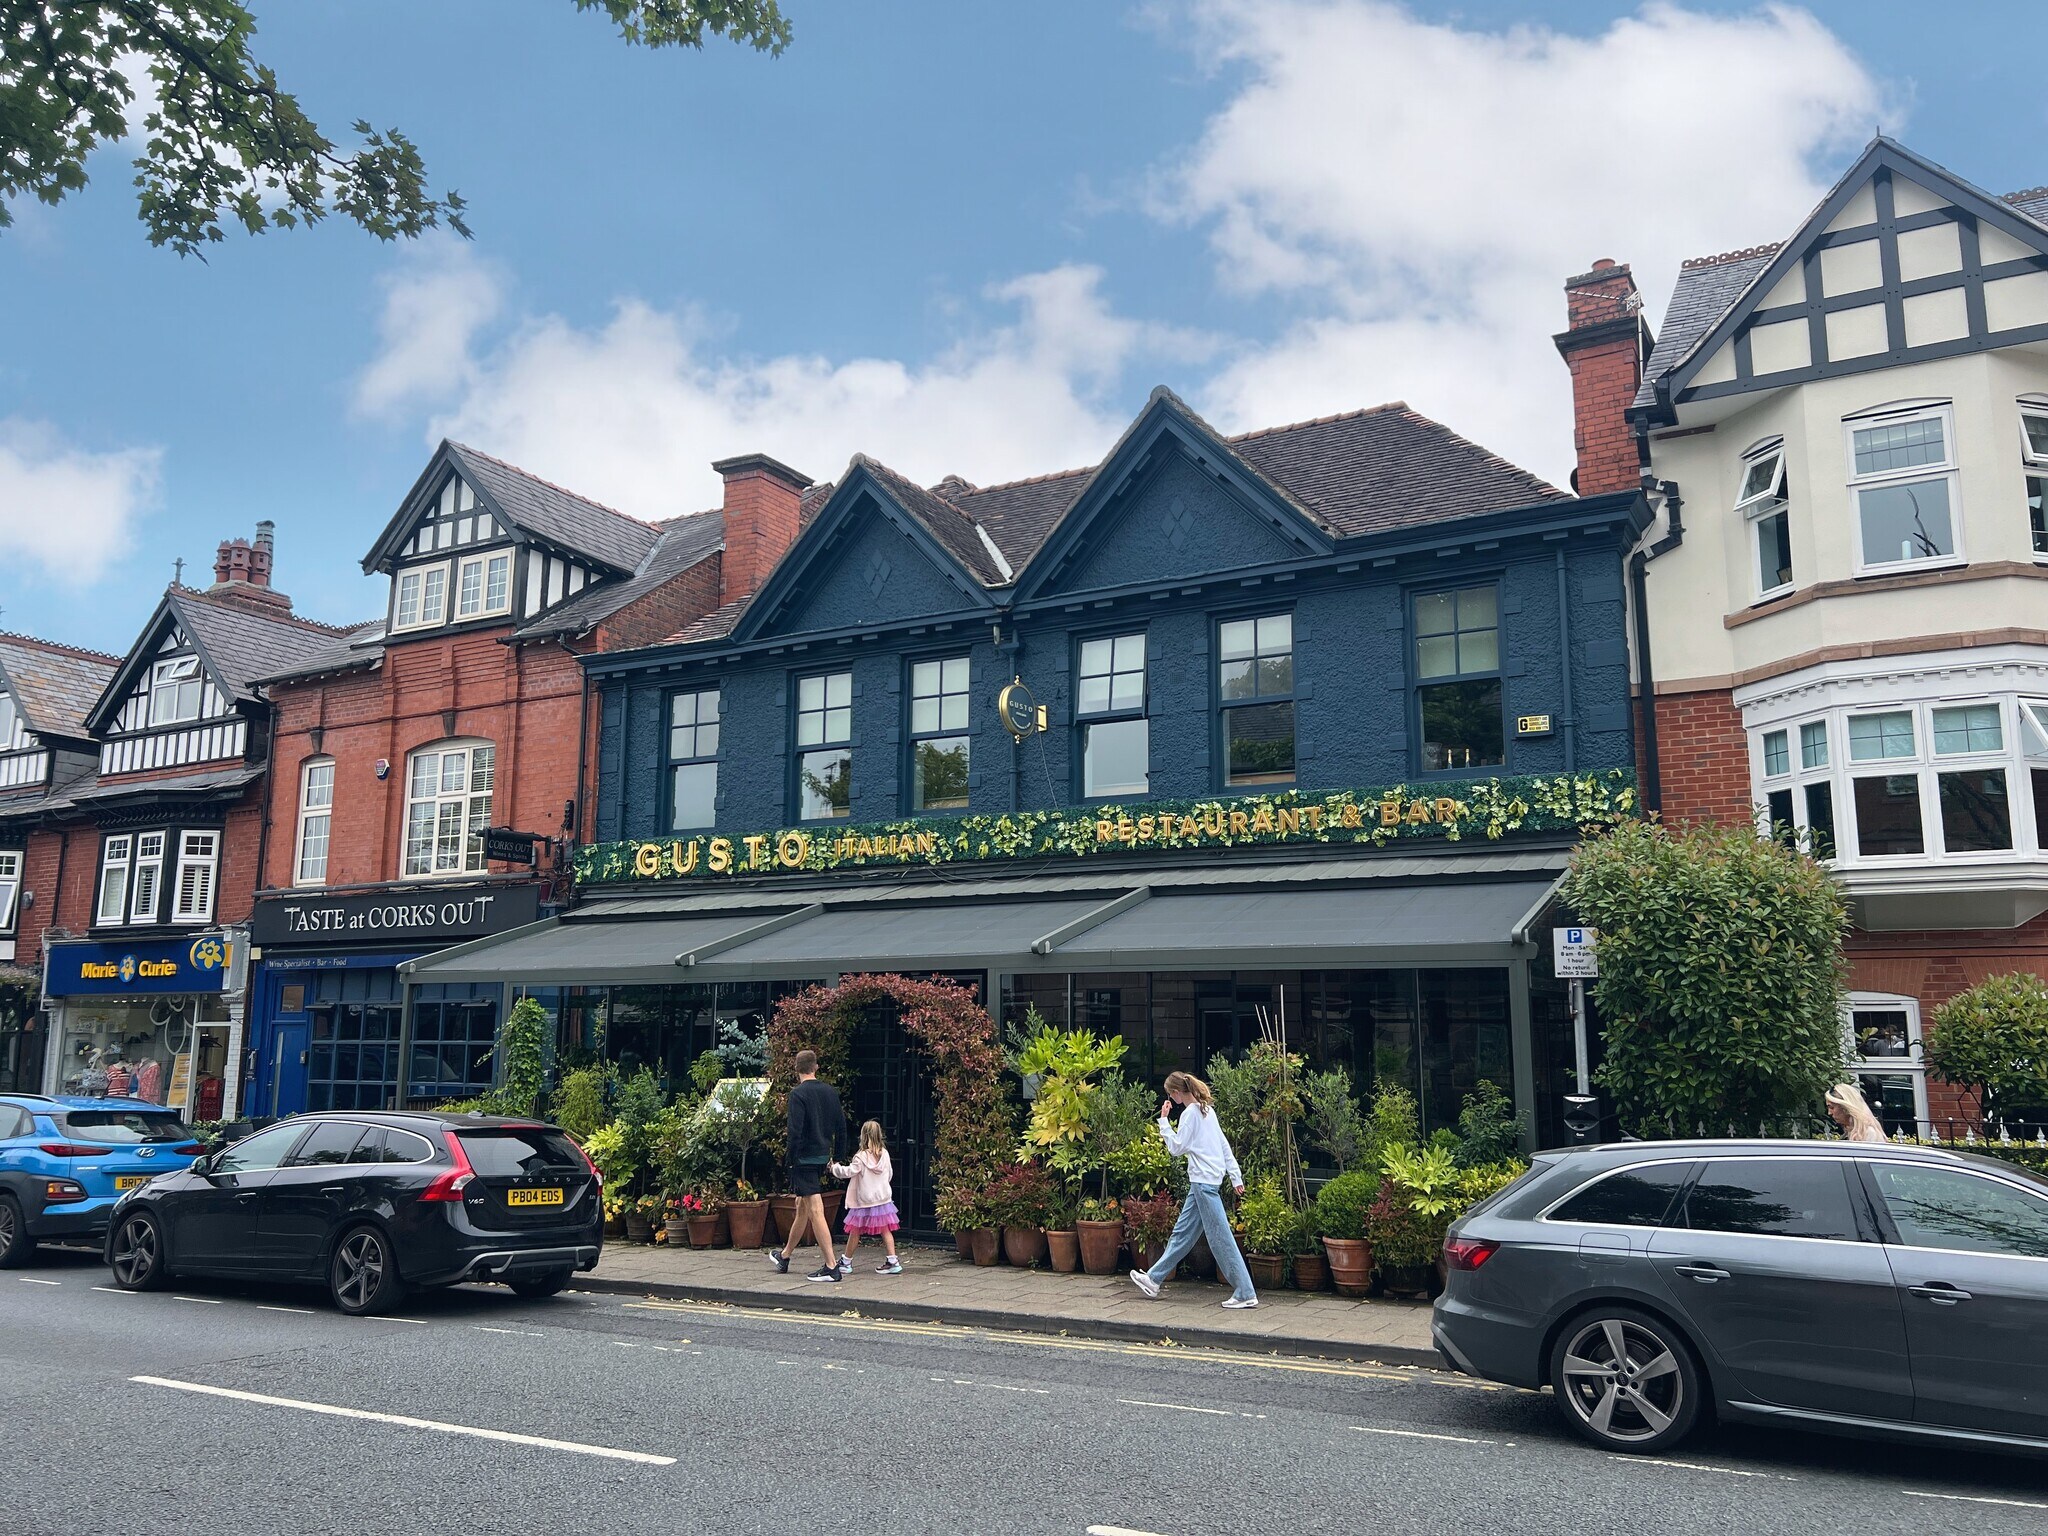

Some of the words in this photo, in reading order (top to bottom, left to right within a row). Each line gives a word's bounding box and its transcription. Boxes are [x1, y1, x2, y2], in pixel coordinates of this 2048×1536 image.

[1009, 700, 1033, 713] GUSTO
[1096, 806, 1322, 842] RESTAURANT
[1341, 804, 1363, 829] &
[1380, 797, 1457, 827] BAR
[488, 839, 514, 851] CORKS
[514, 843, 531, 853] OUT
[635, 833, 809, 876] GUSTO
[834, 832, 932, 859] ITALIAN
[284, 906, 345, 931] TASTE
[350, 912, 365, 929] at
[368, 903, 436, 929] CORKS
[441, 896, 494, 925] OUT
[81, 961, 118, 979] Marie
[138, 959, 177, 977] Curie
[269, 960, 283, 968] Wine
[283, 959, 311, 969] Specialist
[317, 958, 328, 967] Bar
[333, 957, 347, 966] Food
[512, 1190, 538, 1203] PB04
[541, 1190, 560, 1202] EDS
